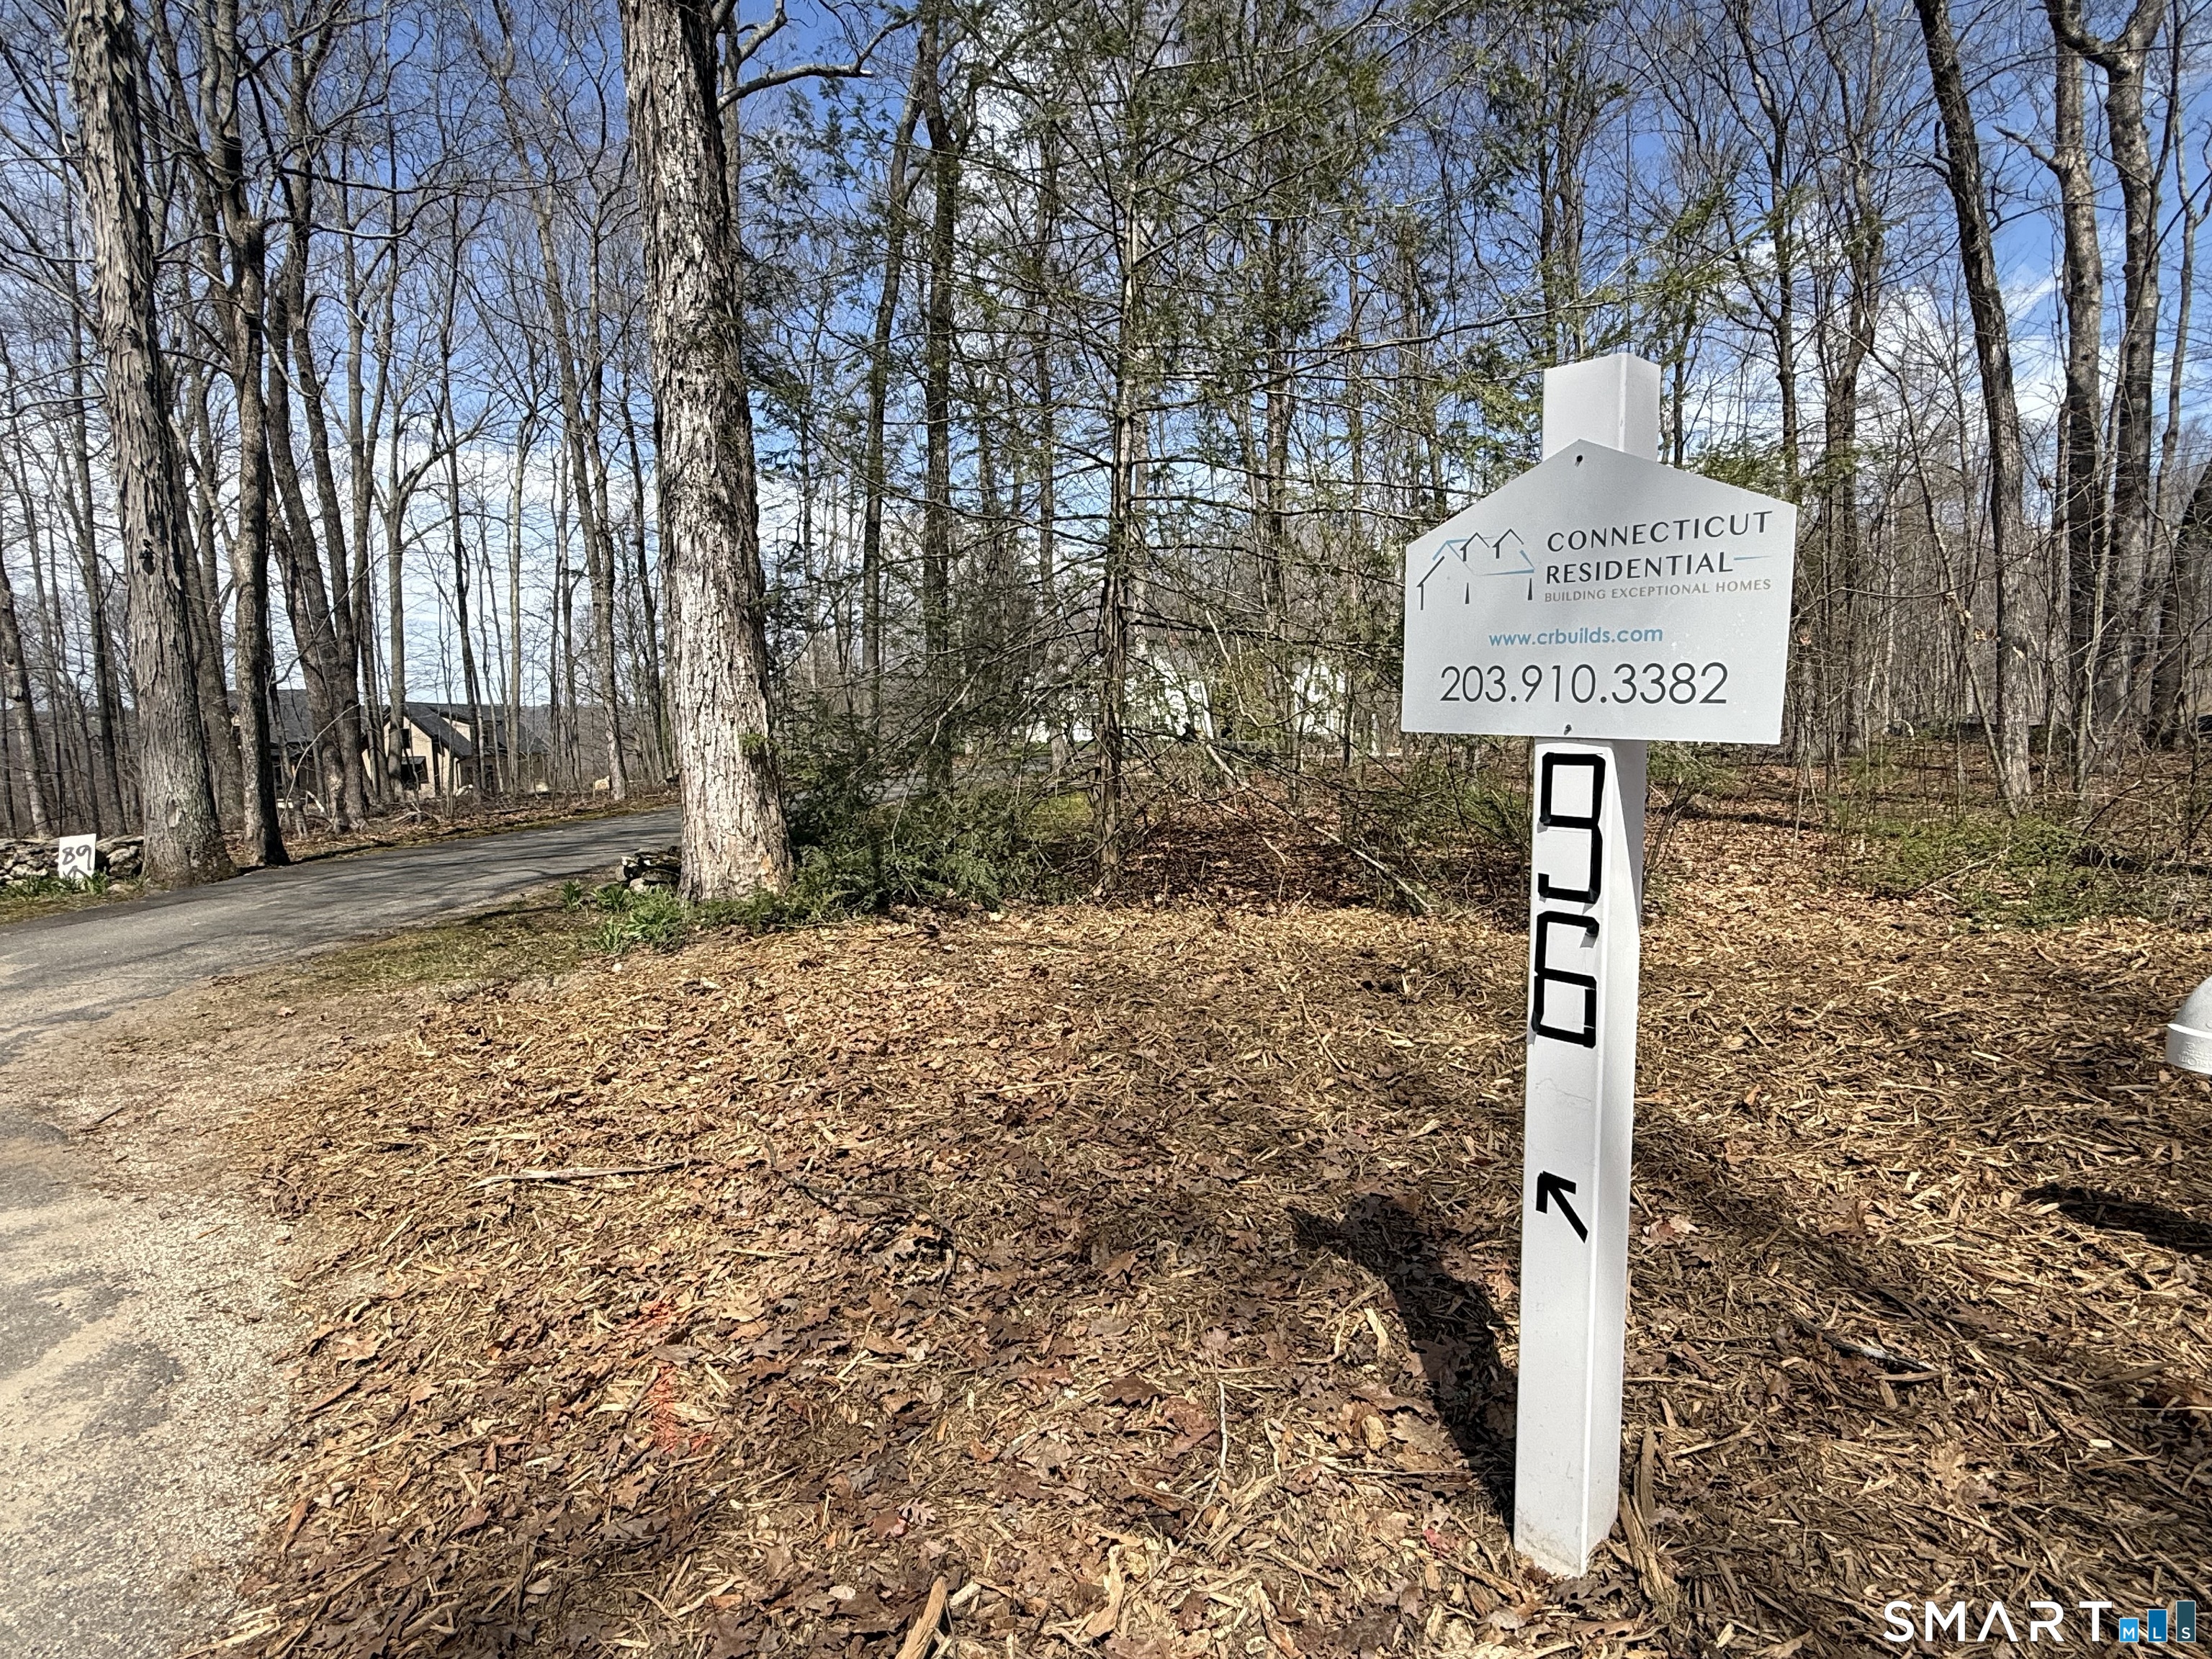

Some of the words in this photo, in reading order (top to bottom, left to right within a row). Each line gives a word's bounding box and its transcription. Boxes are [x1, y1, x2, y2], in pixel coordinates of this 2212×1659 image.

[1547, 511, 1773, 552] CONNECTICUT
[1546, 552, 1733, 584] RESIDENTIAL
[1545, 590, 1606, 603] BUILDING
[1611, 583, 1710, 598] EXCEPTIONAL
[1715, 579, 1771, 593] HOMES
[1488, 626, 1663, 647] www.crbuilds.com
[1440, 662, 1728, 704] 203.910.3382
[62, 845, 92, 871] 89
